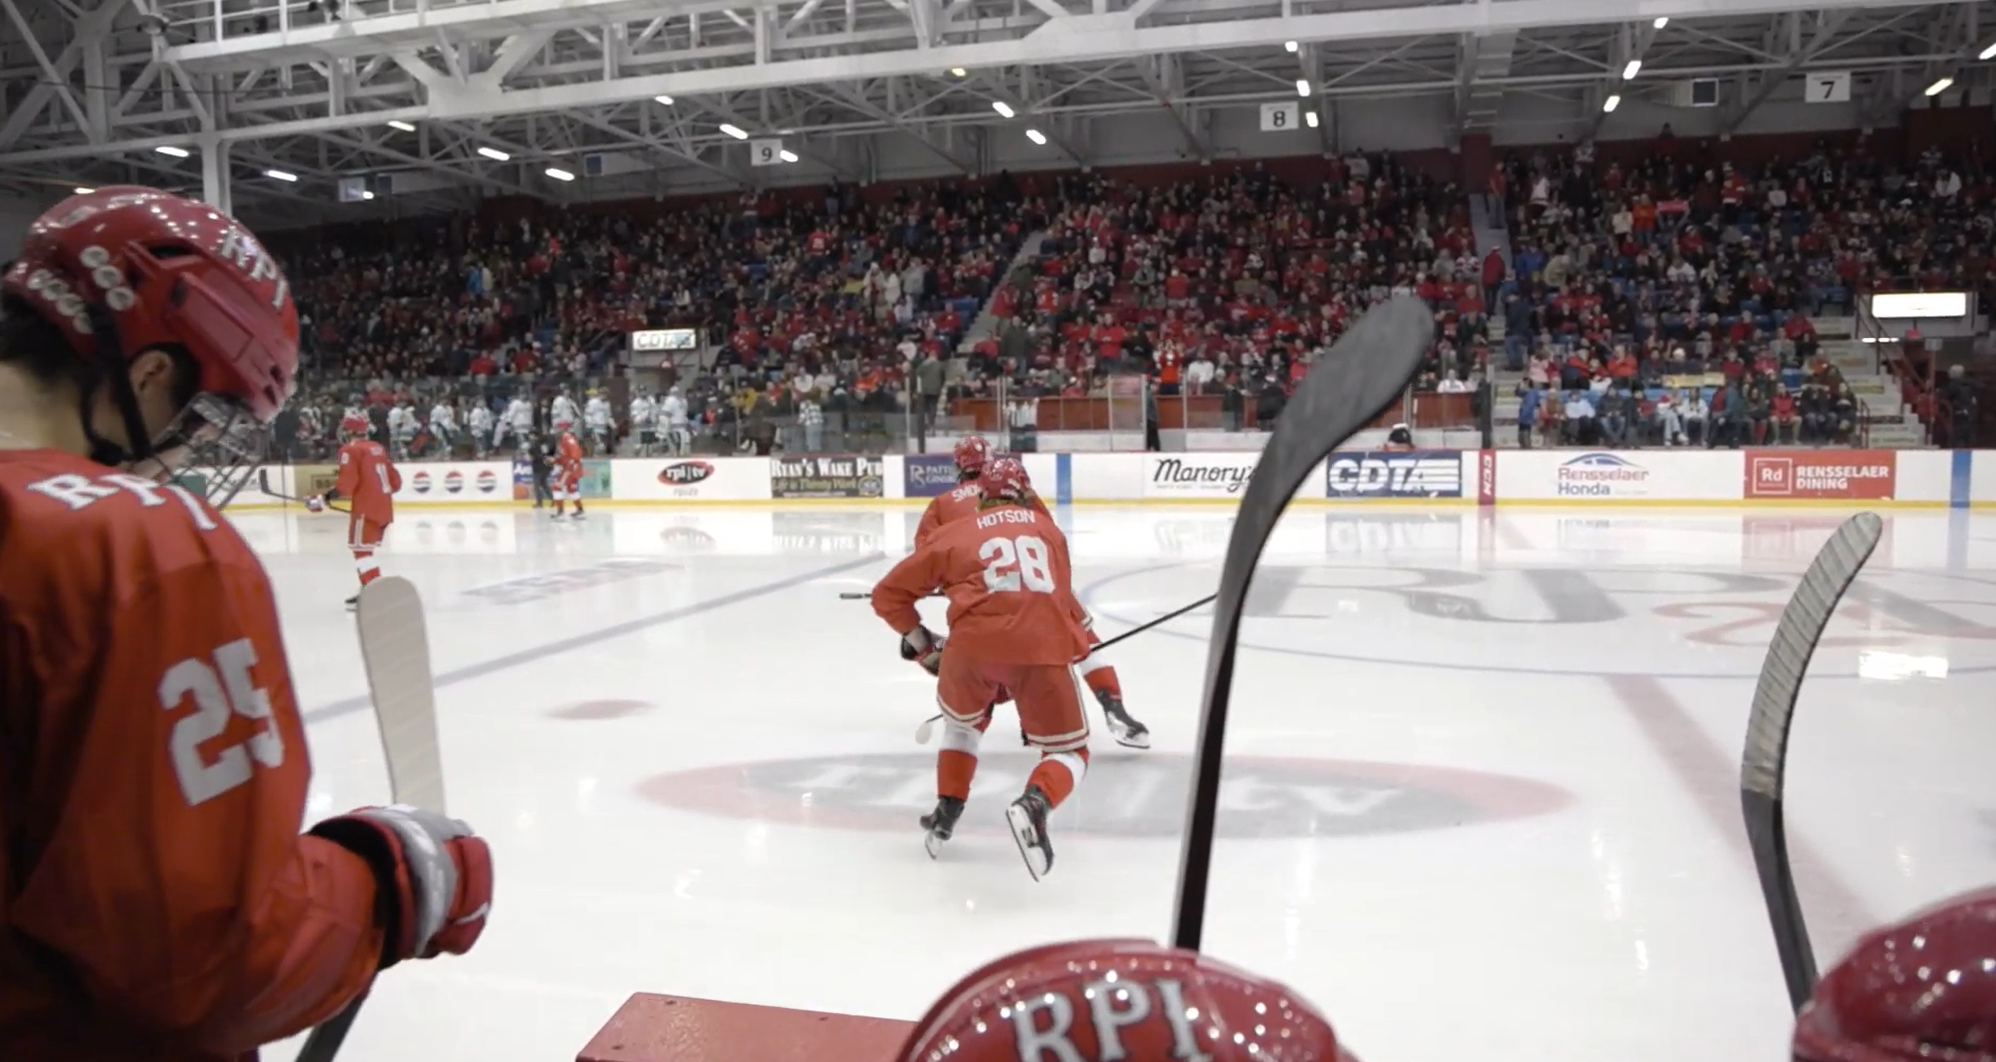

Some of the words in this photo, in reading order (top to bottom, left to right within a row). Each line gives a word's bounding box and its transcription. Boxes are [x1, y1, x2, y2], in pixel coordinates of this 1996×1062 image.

[1820, 80, 1834, 99] 7
[1273, 110, 1286, 128] 8
[761, 146, 773, 162] 9
[221, 225, 290, 310] RPI
[771, 458, 815, 477] RYAN'S
[817, 458, 853, 476] WAKE
[857, 457, 883, 476] PUB
[1329, 459, 1459, 491] CDTA
[1483, 455, 1492, 496] CCM
[1558, 467, 1649, 481] Rensselaer
[1761, 468, 1783, 482] Rd
[1796, 466, 1889, 478] RENSSELAER
[1558, 482, 1611, 495] Honda
[1796, 478, 1848, 490] DINING
[976, 509, 1036, 530] HOTSON
[978, 535, 1056, 594] 28
[157, 637, 284, 806] 25
[1012, 978, 1213, 1062] RPI
